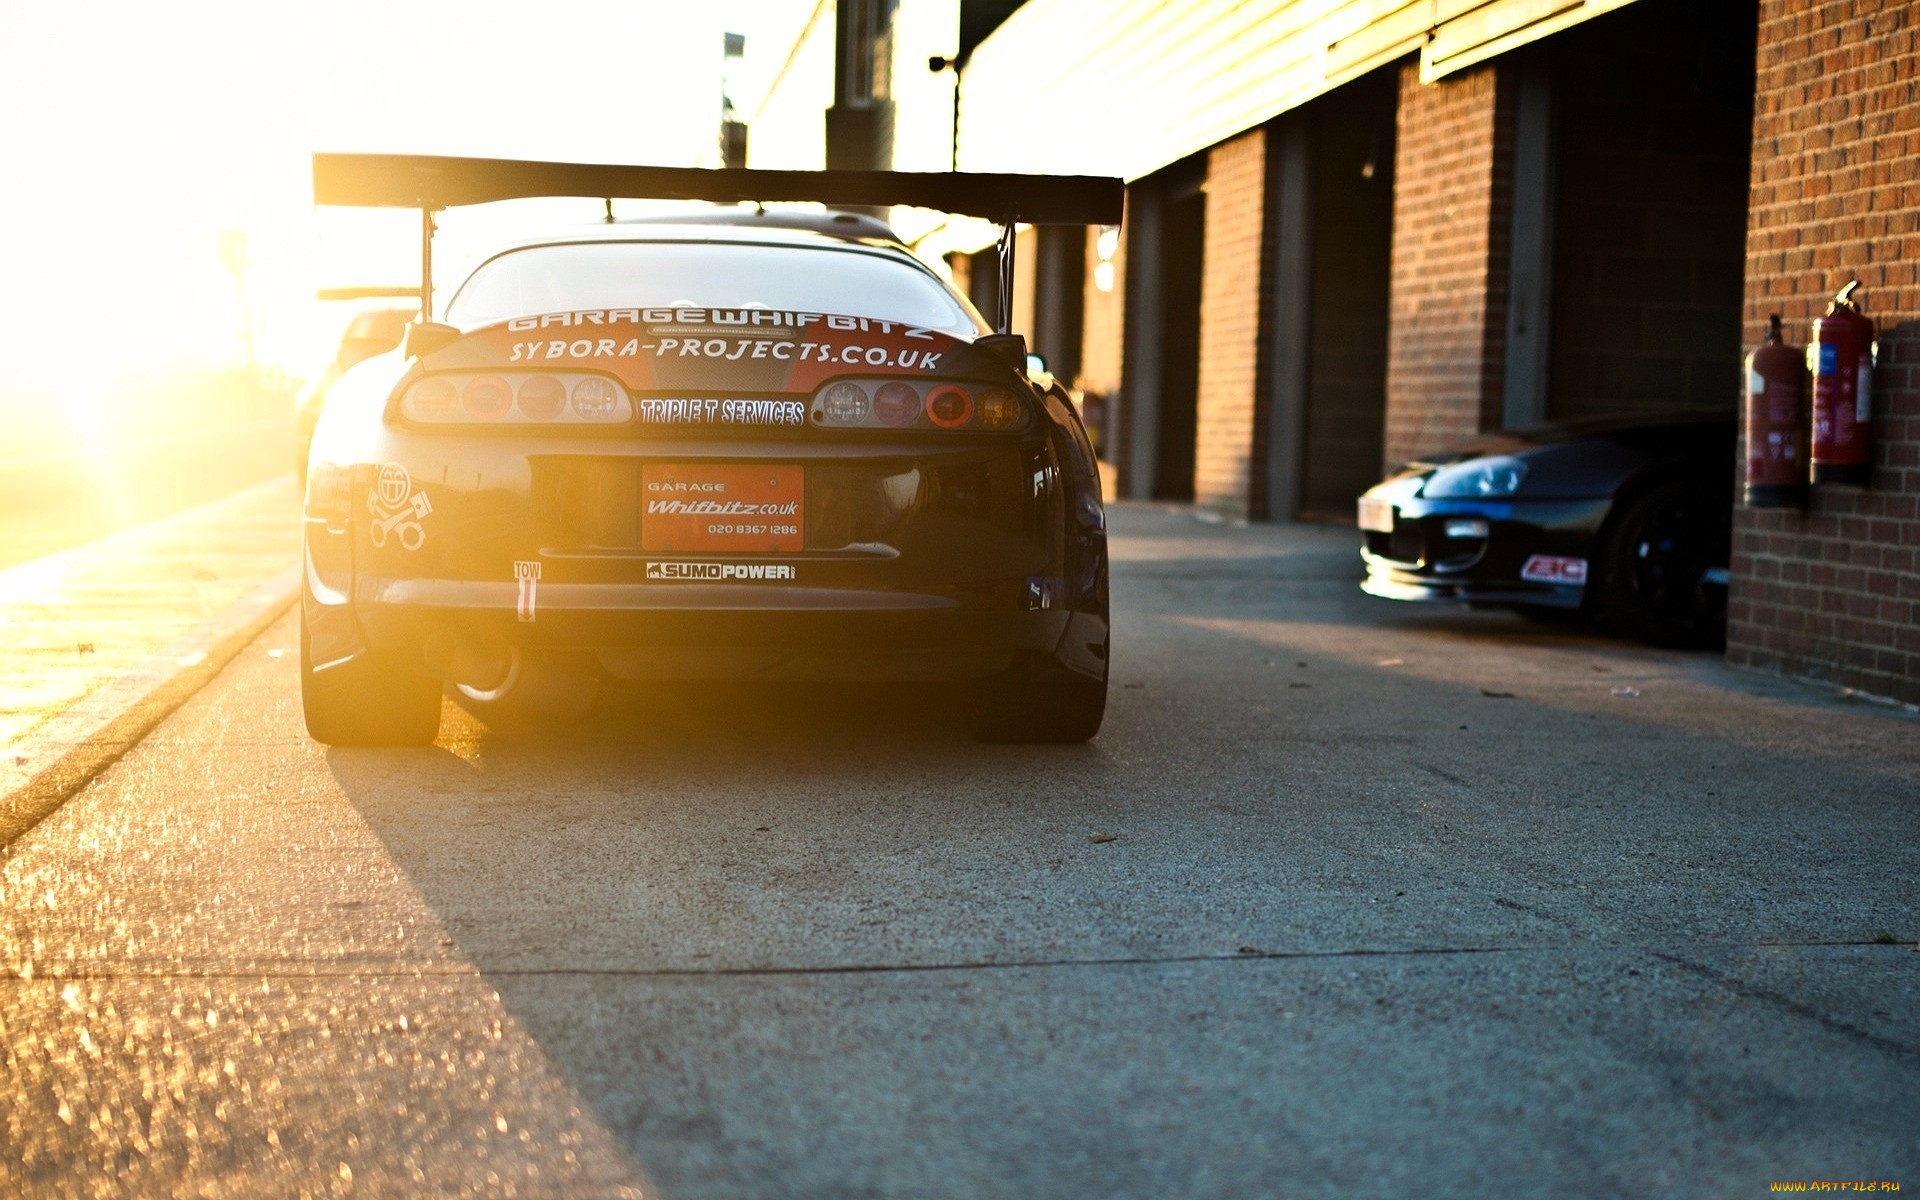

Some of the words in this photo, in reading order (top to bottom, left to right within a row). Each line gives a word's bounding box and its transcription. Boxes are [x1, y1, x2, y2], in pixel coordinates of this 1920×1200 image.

[509, 338, 942, 370] SYBORA-PROJECTS.CO.UK
[641, 399, 702, 423] TRIPLE
[705, 399, 718, 423] T
[722, 400, 804, 425] SERVICES
[648, 482, 725, 492] GARAGE
[648, 500, 798, 515] Whifbitz.co.uk
[708, 524, 733, 534] 020
[736, 524, 767, 534] 8367
[770, 525, 797, 535] 1286
[515, 563, 540, 578] TOW
